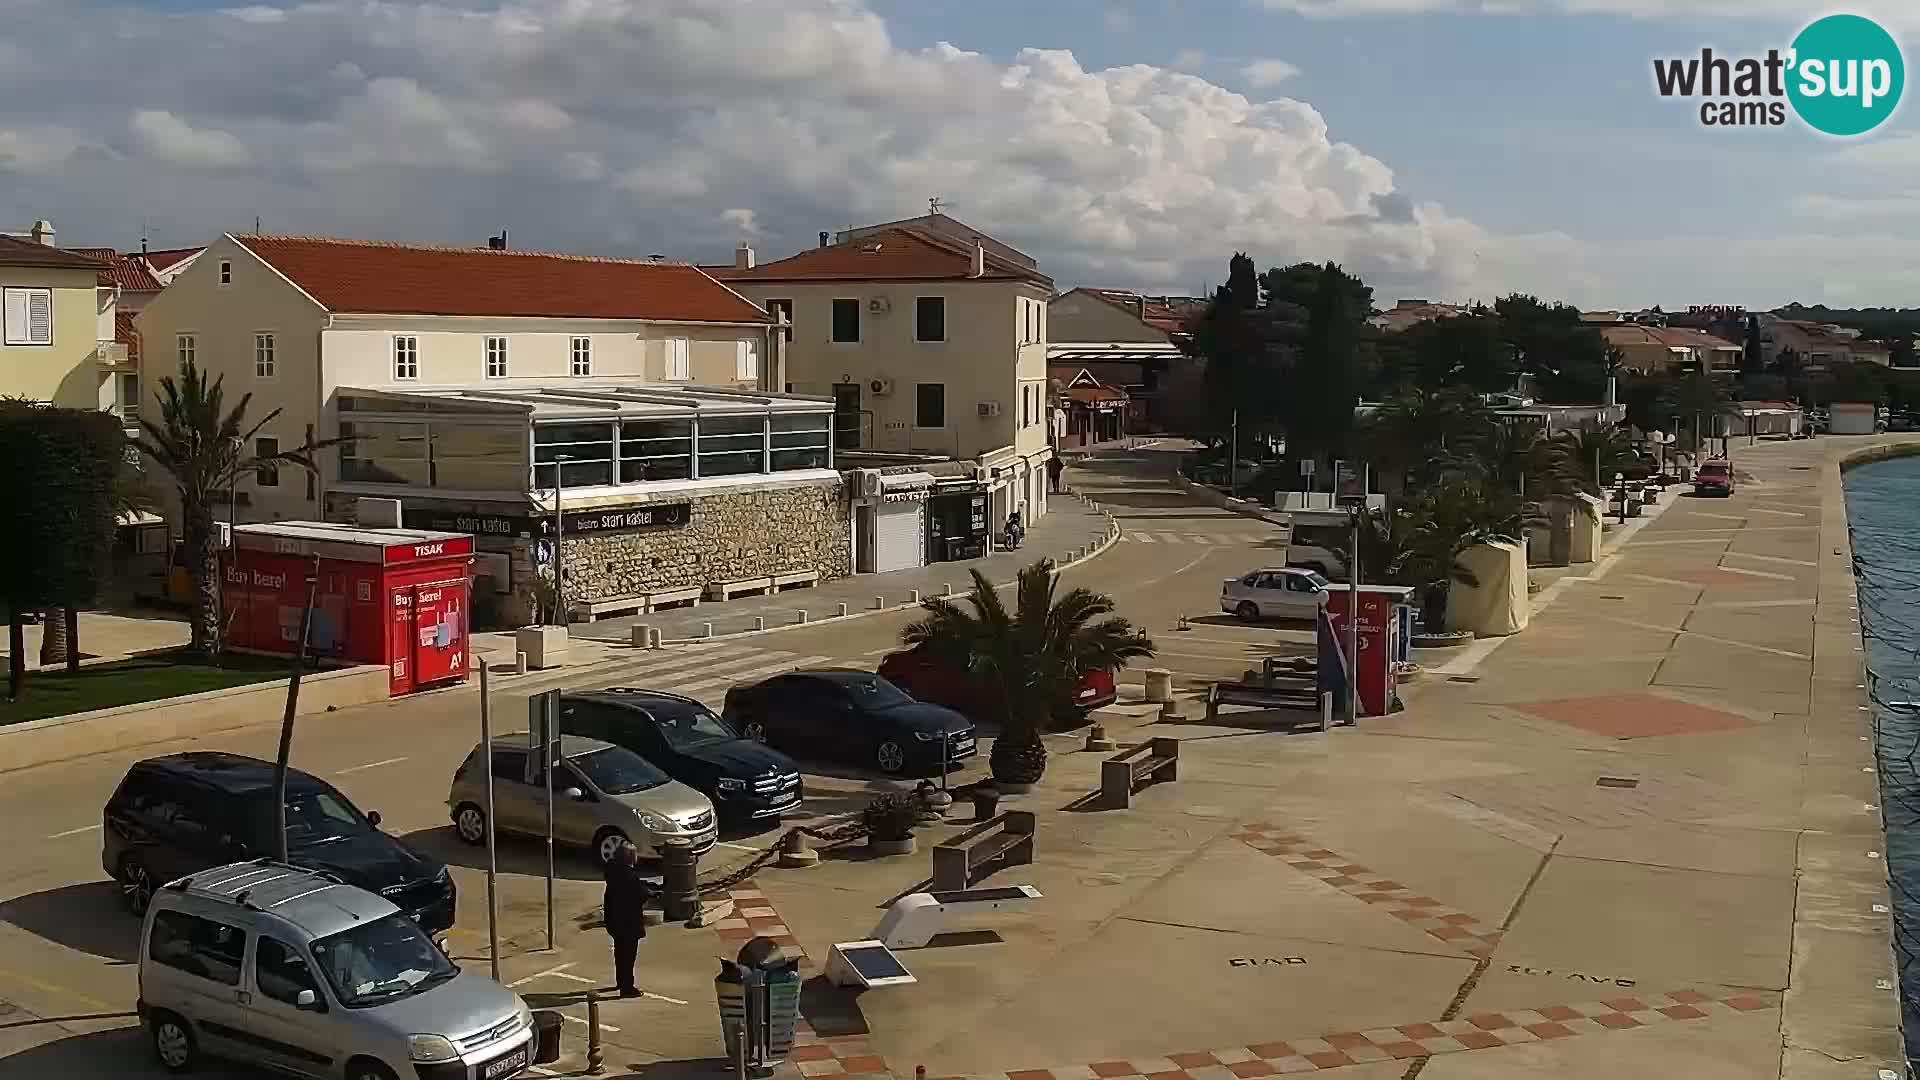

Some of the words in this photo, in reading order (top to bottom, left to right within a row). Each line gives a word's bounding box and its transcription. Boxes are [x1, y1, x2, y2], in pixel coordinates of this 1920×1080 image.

[414, 543, 444, 557] TISAK
[395, 594, 412, 607] Buy
[418, 588, 442, 603] here!
[449, 650, 462, 670] A1
